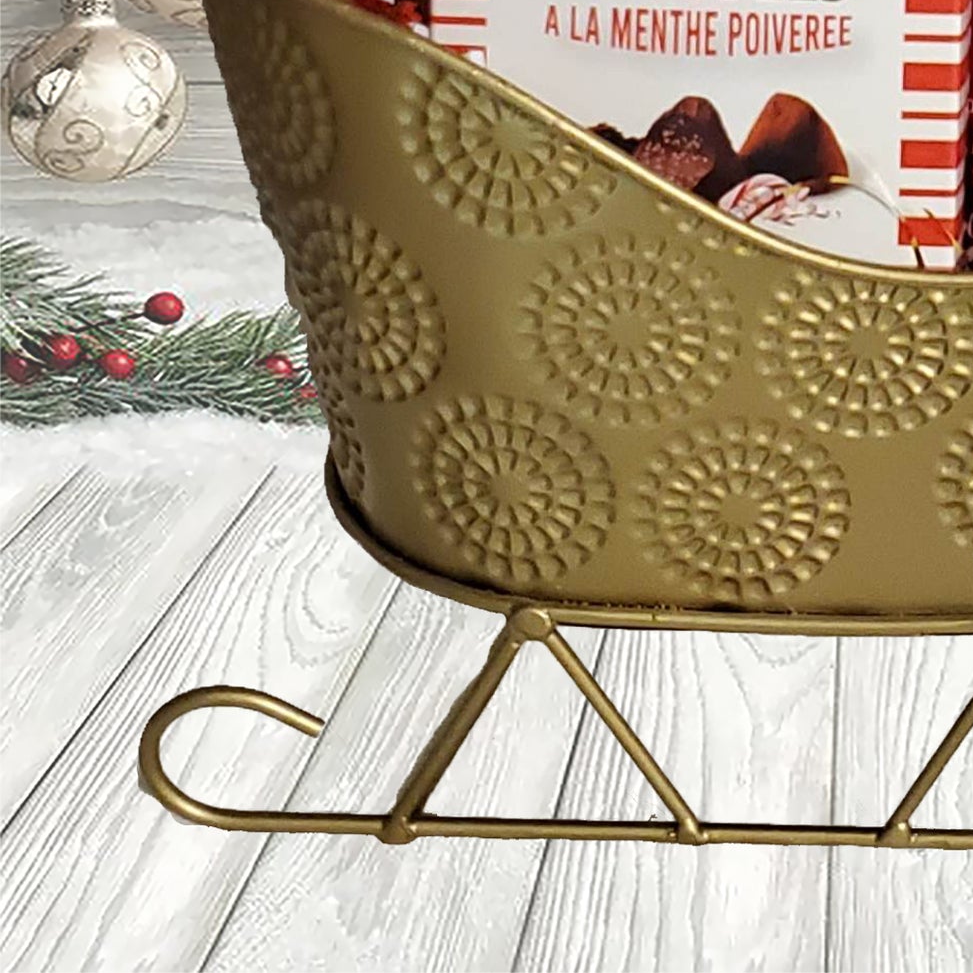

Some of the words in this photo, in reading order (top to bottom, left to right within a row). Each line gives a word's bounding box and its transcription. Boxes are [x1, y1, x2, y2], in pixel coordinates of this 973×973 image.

[544, 4, 560, 37] A
[570, 5, 600, 46] LA
[611, 6, 718, 56] MENTHE
[728, 11, 853, 57] POIVEREE
